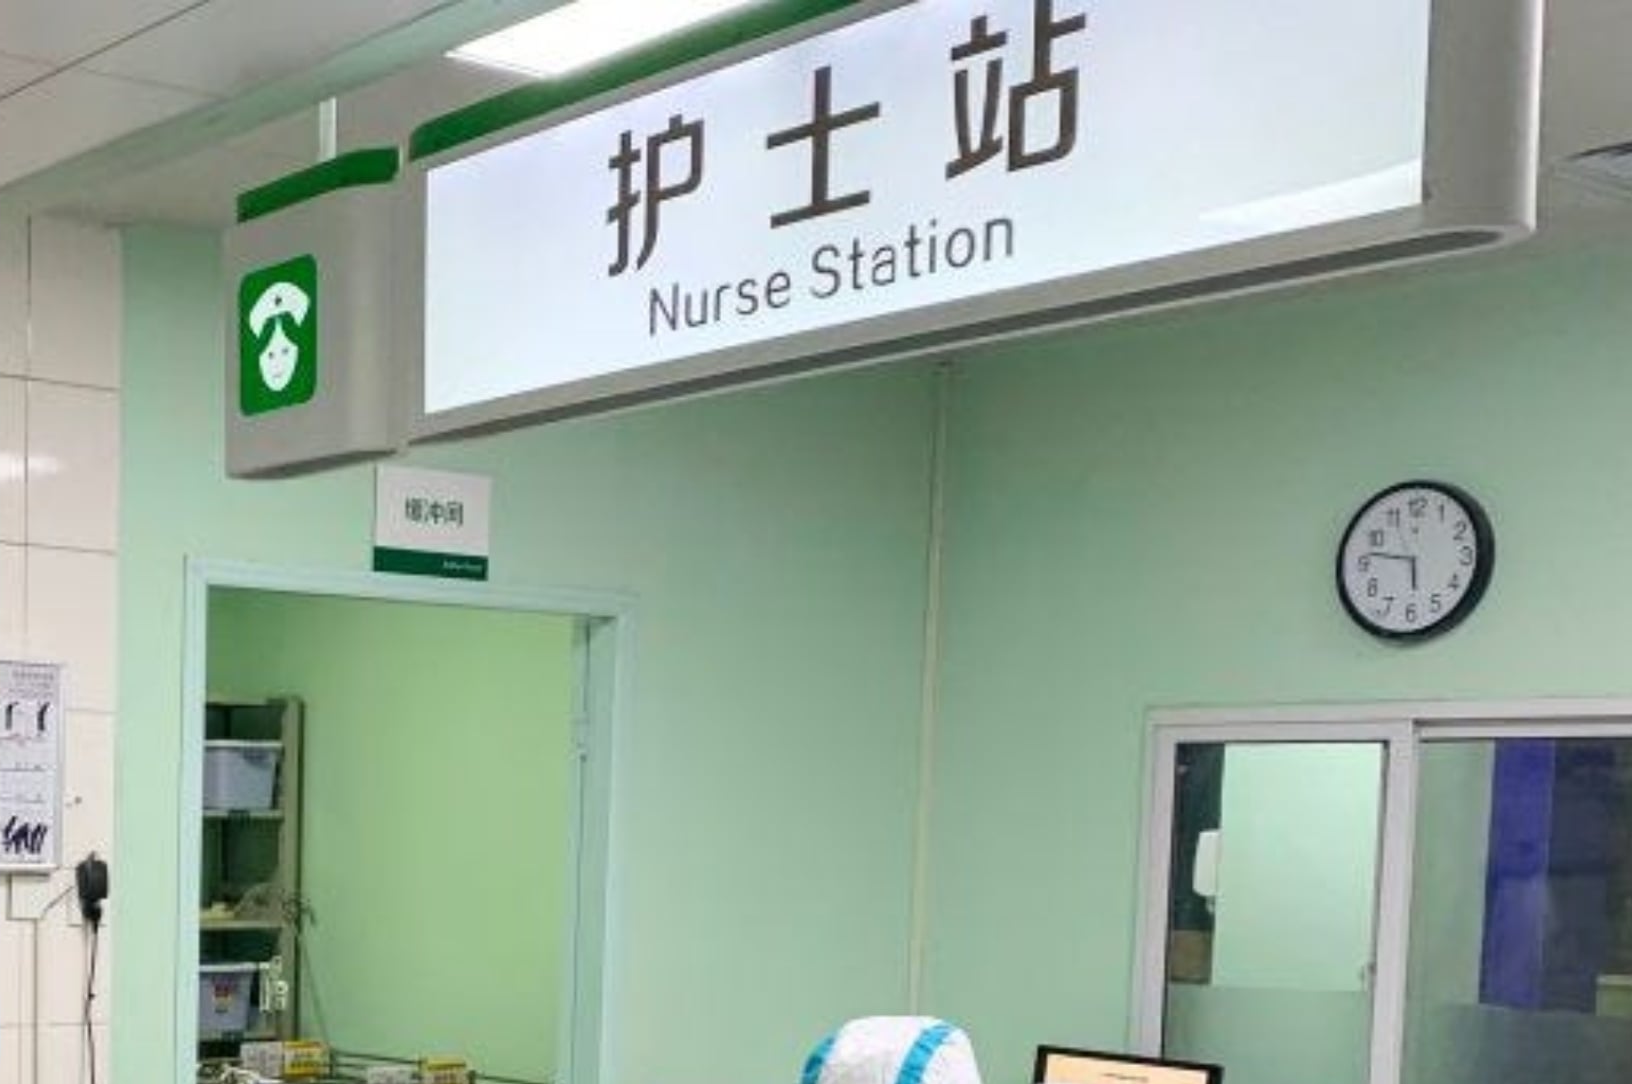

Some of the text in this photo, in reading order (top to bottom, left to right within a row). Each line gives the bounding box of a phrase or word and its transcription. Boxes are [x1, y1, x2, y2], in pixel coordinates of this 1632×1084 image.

[607, 0, 1087, 278] 护士站
[649, 216, 1015, 337] Nurse Station
